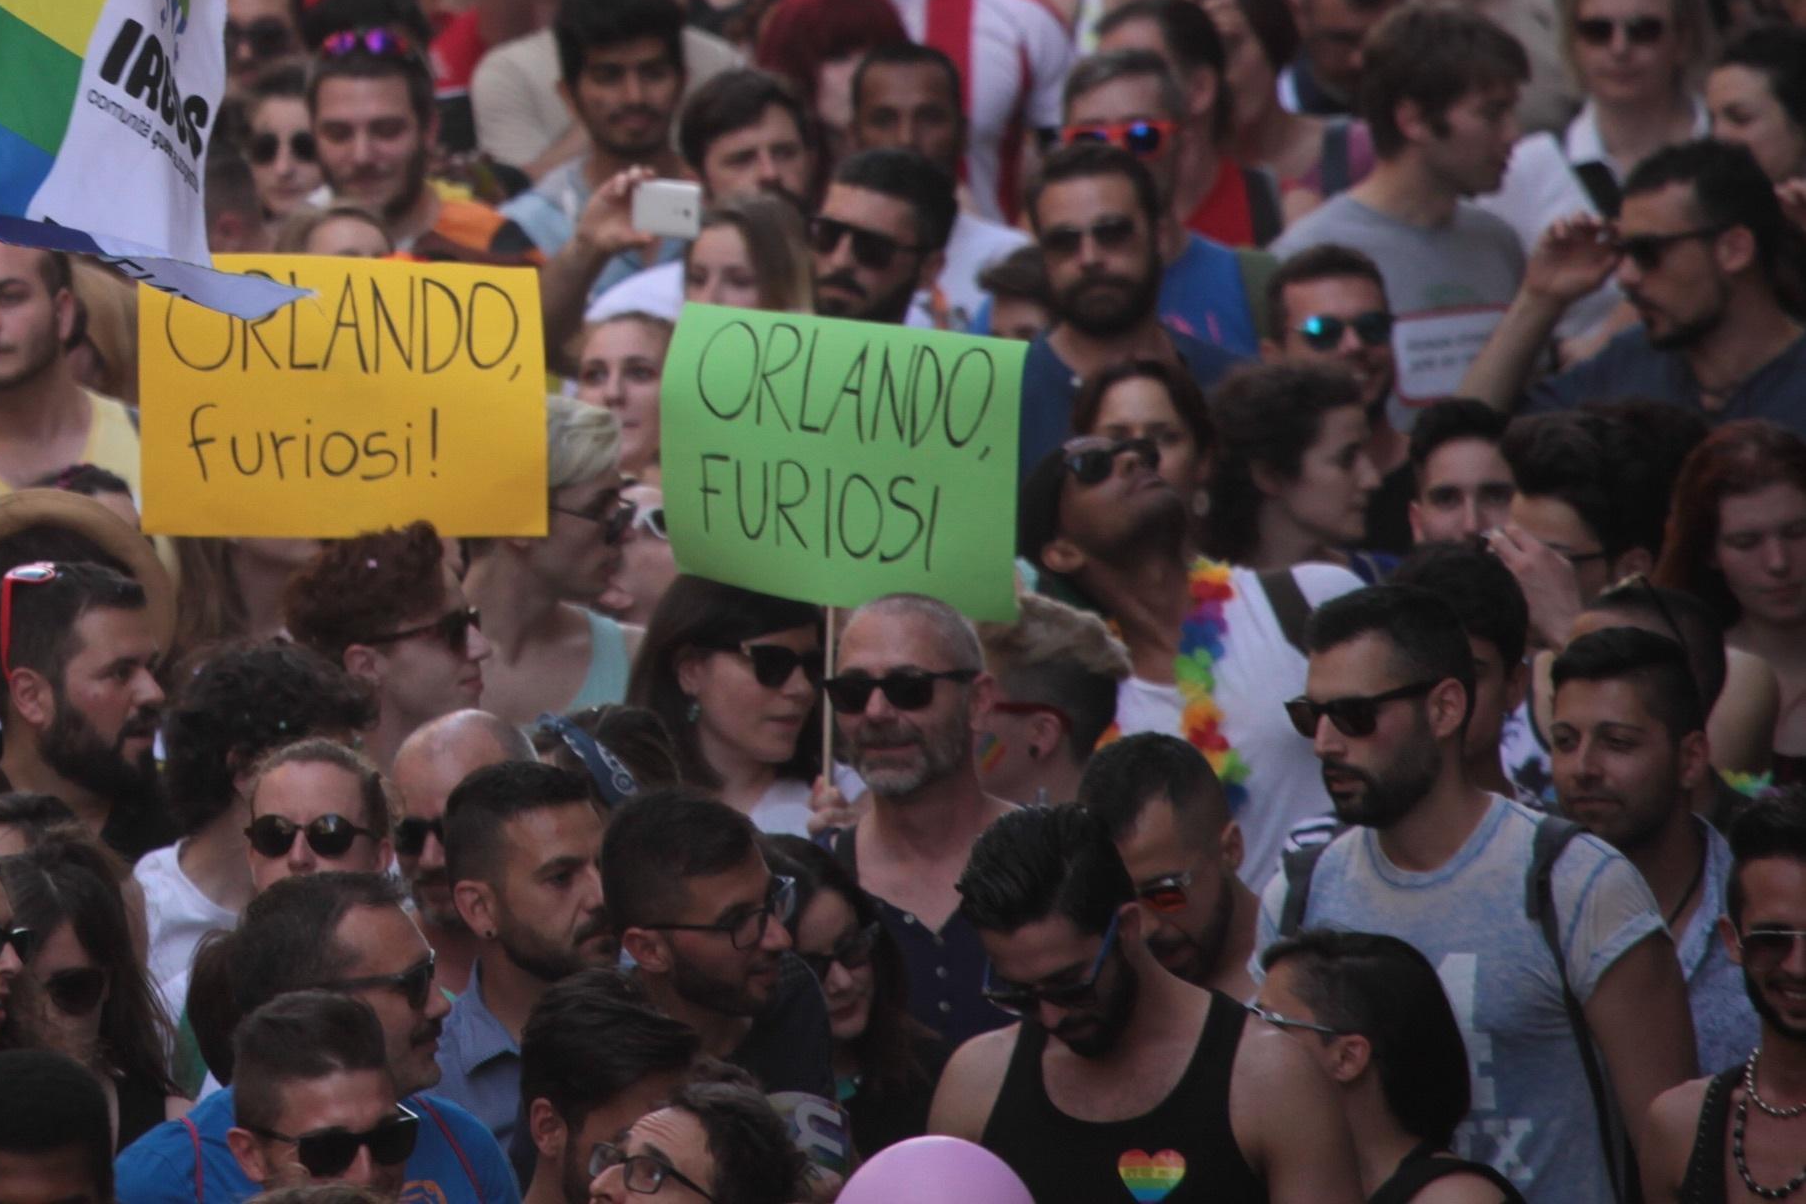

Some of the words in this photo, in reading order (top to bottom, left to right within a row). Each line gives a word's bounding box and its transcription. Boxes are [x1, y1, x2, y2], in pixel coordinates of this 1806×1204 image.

[164, 268, 523, 383] ORLANDO,
[187, 403, 439, 483] furiosi!
[697, 320, 993, 461] ORLANDO,
[698, 453, 941, 573] FURIOSI
